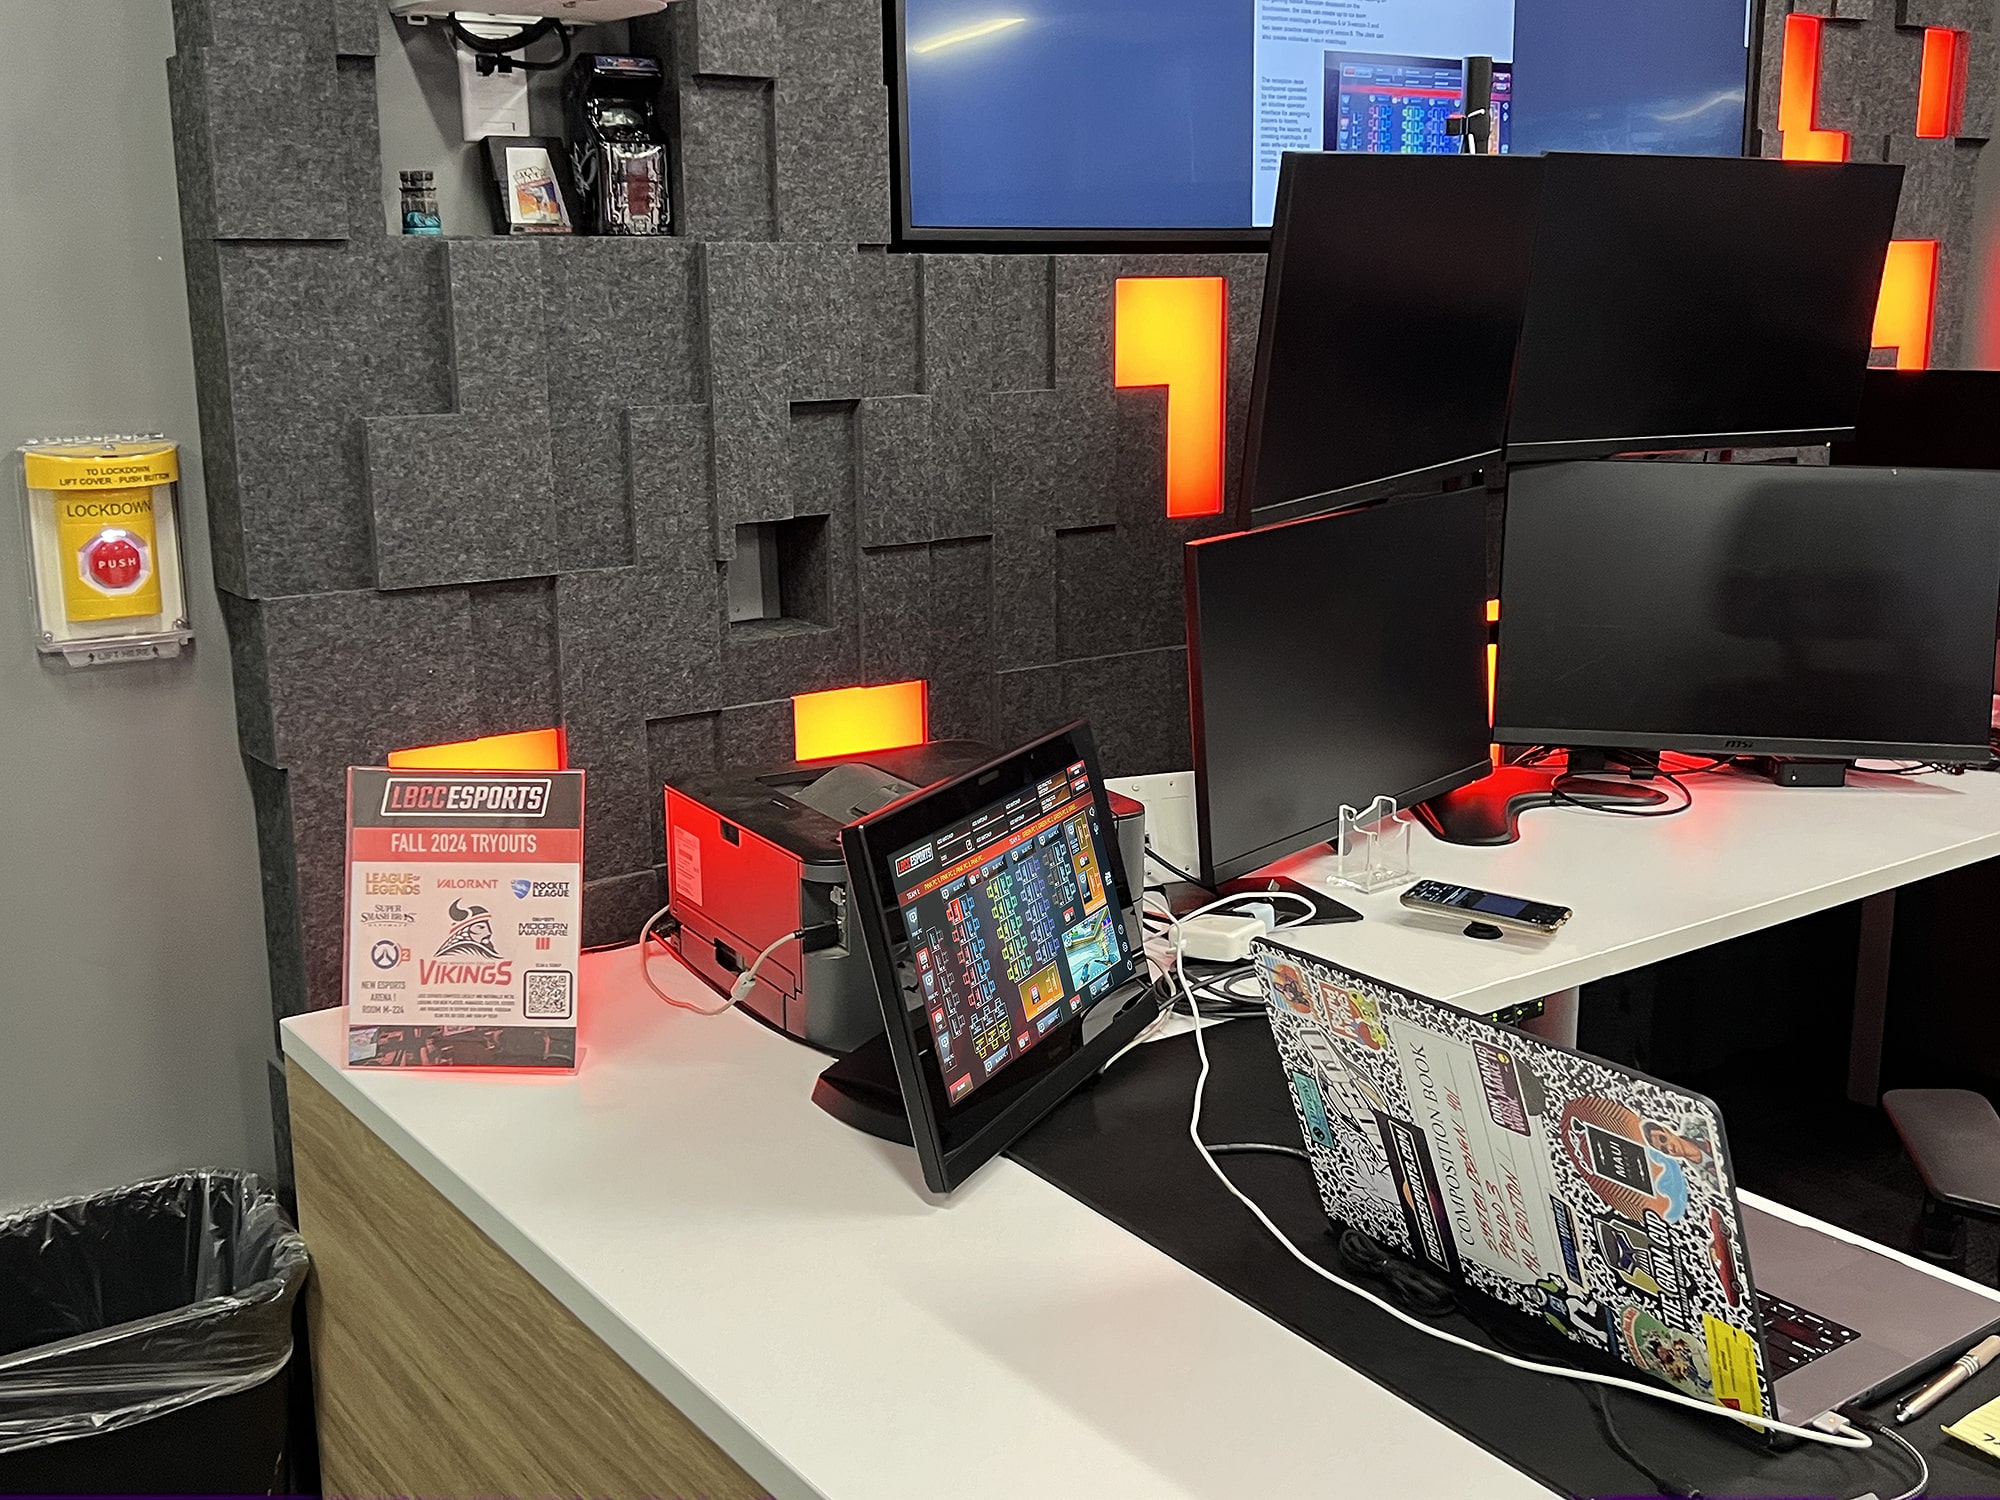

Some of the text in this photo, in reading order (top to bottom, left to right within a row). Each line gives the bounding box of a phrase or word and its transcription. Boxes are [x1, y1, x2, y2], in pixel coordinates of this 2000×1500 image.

[101, 466, 150, 474] LOCKDOWN
[144, 473, 169, 481] BUTTON
[67, 500, 151, 517] LOCKDOWN
[98, 557, 137, 569] PUSH
[391, 785, 544, 810] LBCCESPORTS
[391, 833, 537, 853] FALL 2024 TRYOUTS
[366, 873, 413, 883] LEAGUE
[366, 885, 420, 895] LEGENDS
[437, 879, 499, 888] VALORANT
[533, 882, 569, 890] ROCKET
[419, 959, 513, 985] VIKINGS
[361, 981, 405, 989] NEW ESPORTS
[362, 1006, 381, 1014] ROOM
[1474, 1042, 1505, 1125] DON'T PANIC!
[1488, 1060, 1506, 1097] MAKE
[1497, 1096, 1515, 1129] JUST
[1506, 1095, 1526, 1132] WORK.
[1409, 1041, 1476, 1246] COMPOSITION BOOK
[1443, 1086, 1498, 1253] SYSTEM DESIGN 401
[1608, 1139, 1627, 1178] MAUI
[1394, 1127, 1443, 1262] BOSCOESPORTS.COM
[1485, 1179, 1519, 1265] PERIOD 3
[1646, 1210, 1685, 1331] THE GRIM CUP
